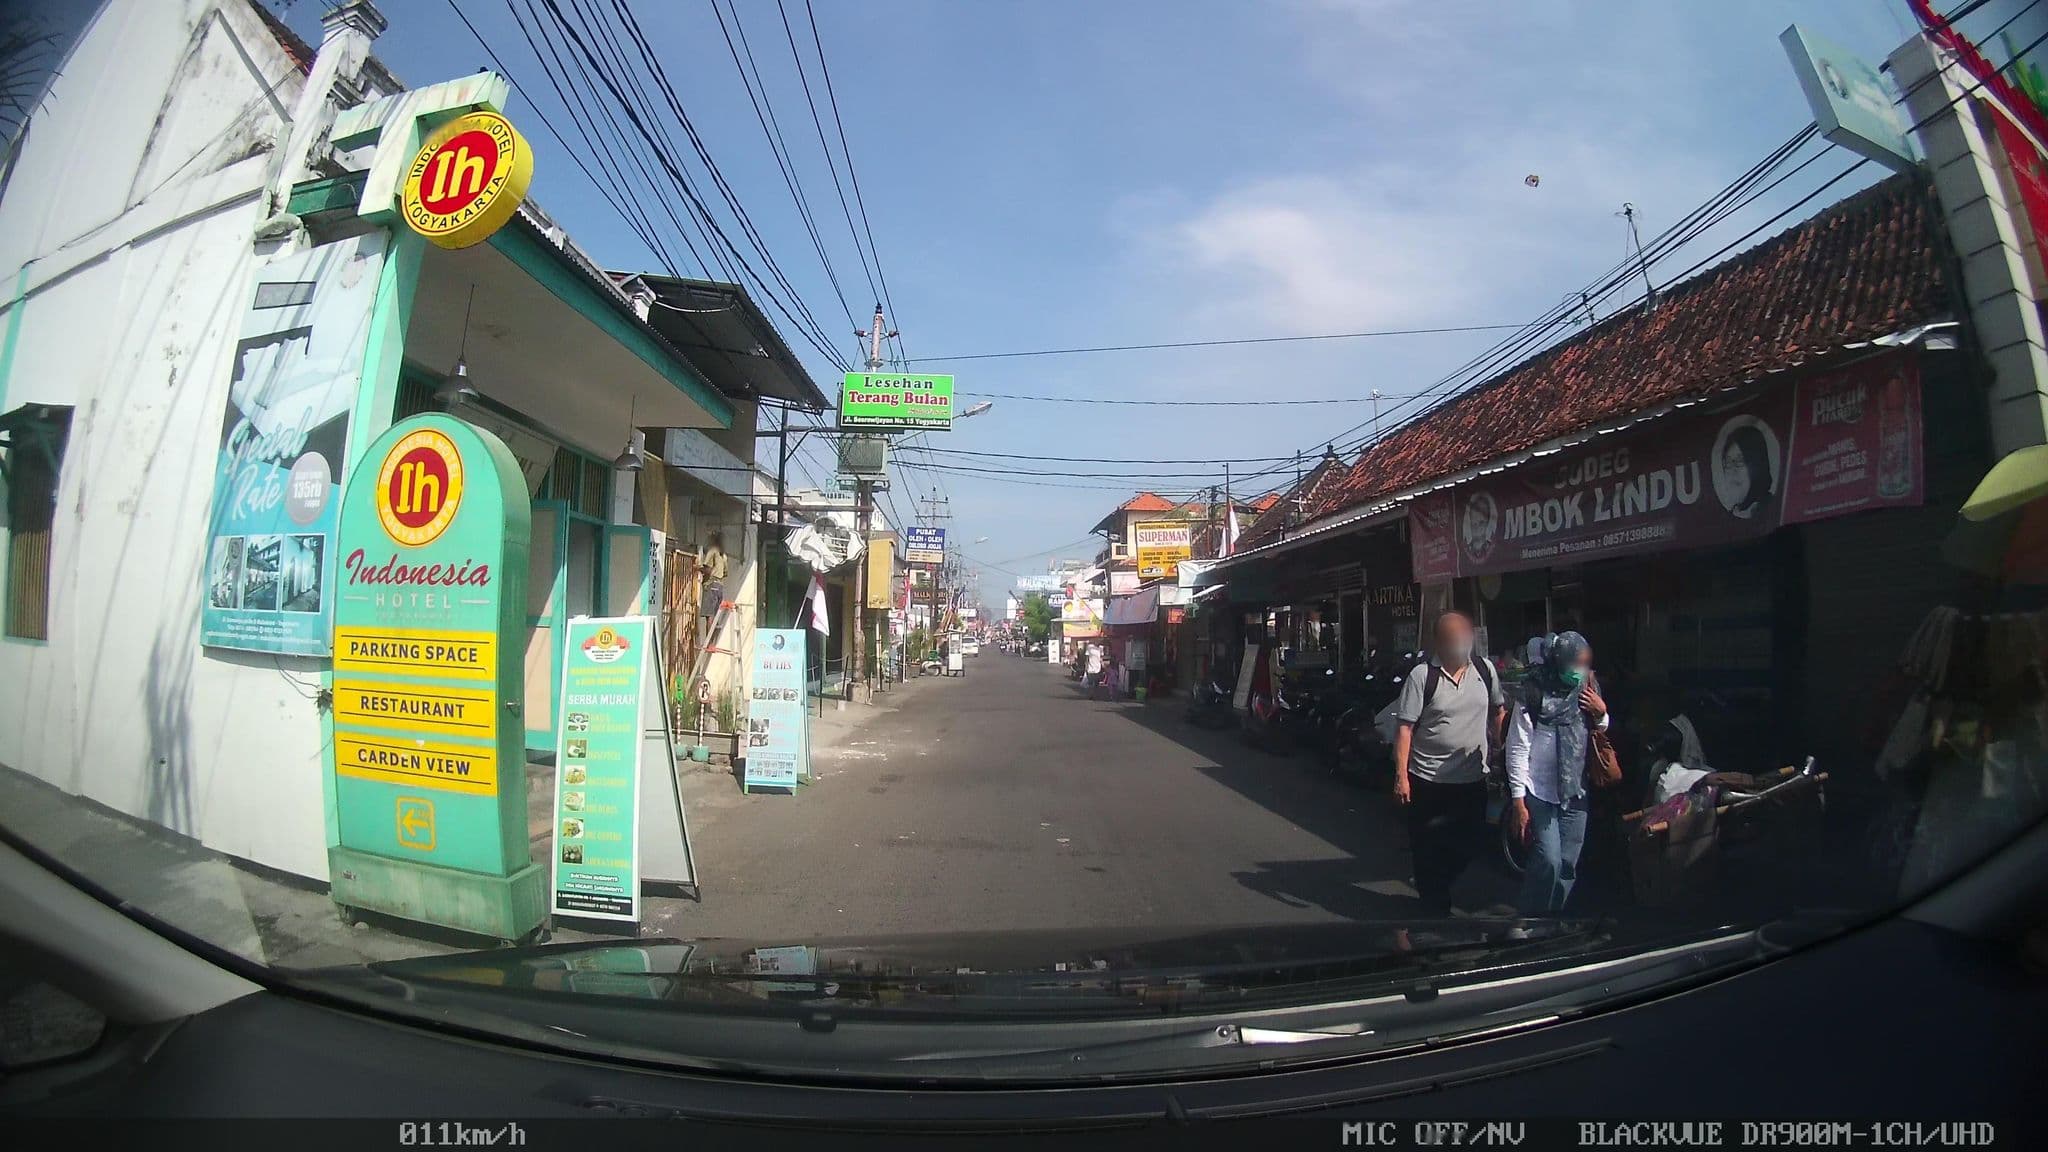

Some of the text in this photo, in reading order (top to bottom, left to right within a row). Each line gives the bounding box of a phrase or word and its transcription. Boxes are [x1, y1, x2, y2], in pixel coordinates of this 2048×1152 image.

[426, 146, 486, 203] Ih
[408, 176, 505, 229] YOGYAKARTA
[864, 376, 934, 390] Lesehan
[848, 391, 948, 406] Terang Bulan
[224, 405, 313, 481] Special
[232, 456, 285, 521] Rate
[395, 461, 440, 514] Ih
[1503, 460, 1701, 541] MBOK LINDU
[1139, 530, 1188, 543] SUPERMAN
[1559, 539, 1597, 554] Pesanan
[345, 547, 491, 588] Indonesia
[375, 592, 453, 610] HOTEL
[350, 641, 478, 663] PARKING SPACE
[359, 695, 466, 720] RESTAURANT
[568, 693, 636, 705] SERBA MURAH
[424, 756, 471, 776] VIEW
